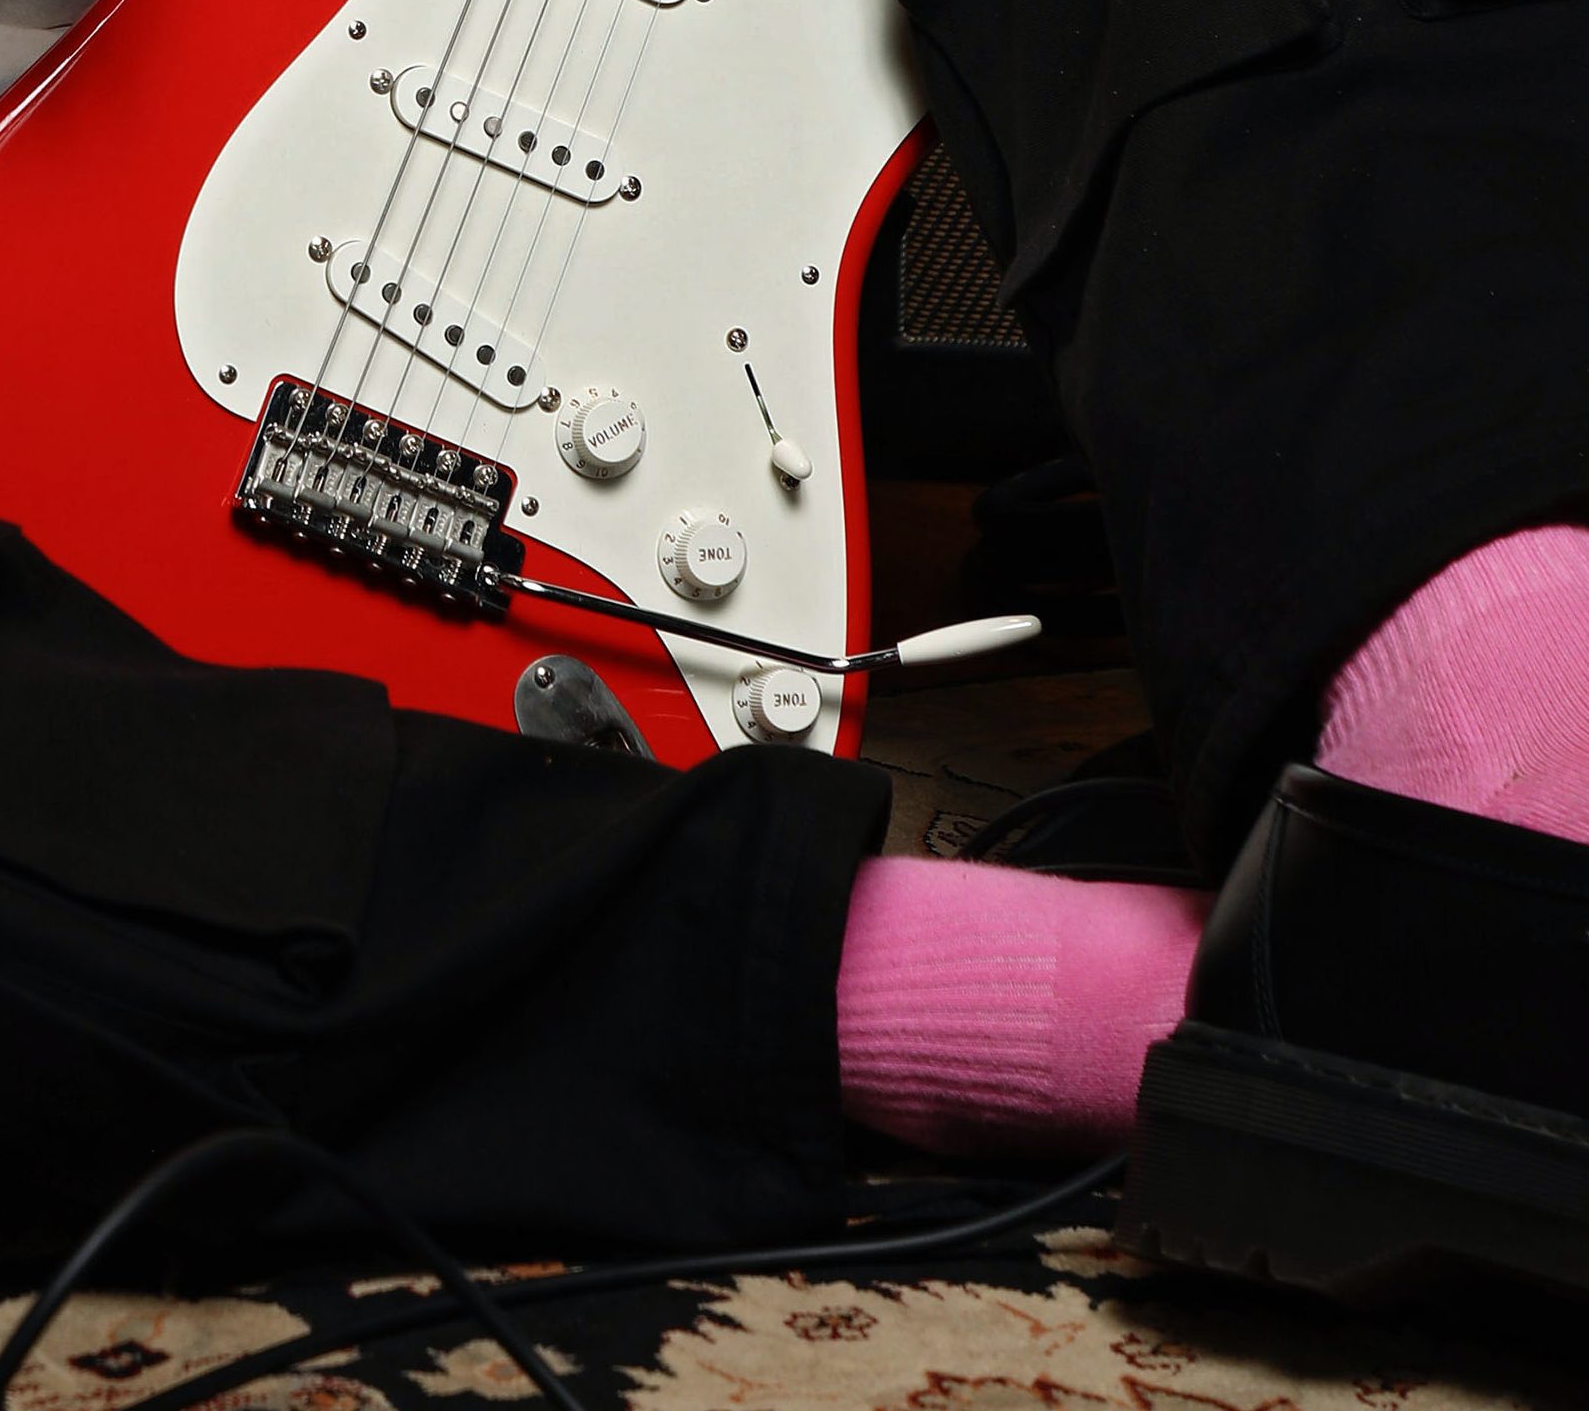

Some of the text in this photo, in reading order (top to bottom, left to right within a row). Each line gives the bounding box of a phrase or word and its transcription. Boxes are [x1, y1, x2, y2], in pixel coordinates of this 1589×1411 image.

[588, 412, 639, 450] VOLUME
[698, 547, 733, 563] TONE
[773, 692, 808, 708] TONE
